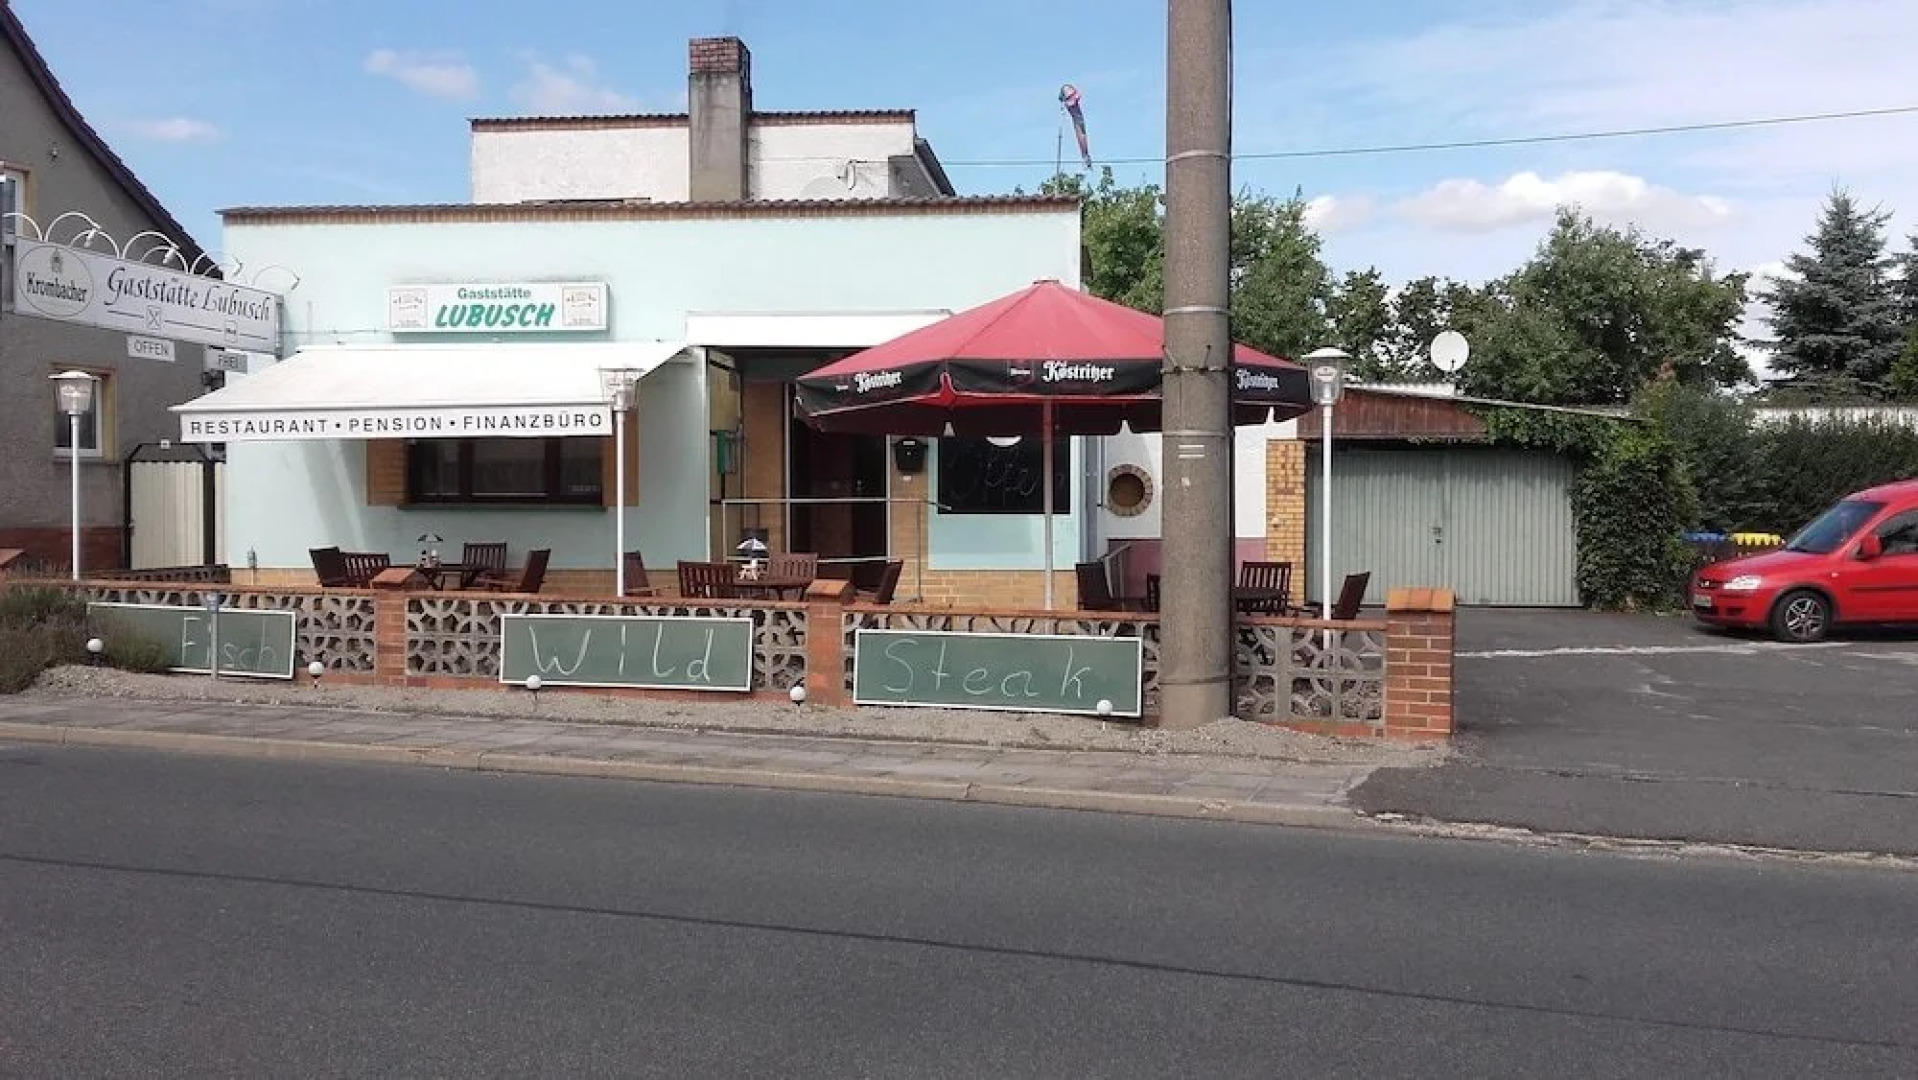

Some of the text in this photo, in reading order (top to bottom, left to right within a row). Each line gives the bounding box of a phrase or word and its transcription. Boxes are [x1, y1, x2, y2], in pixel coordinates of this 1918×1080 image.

[26, 272, 87, 303] Krombacher
[104, 266, 270, 321] Gaststätte Lubusch
[457, 287, 532, 300] Gaststätte
[435, 303, 556, 327] LUBUSCH
[134, 339, 169, 356] OFFEN
[190, 410, 602, 435] RESTAURANT PENSION FINANZBÜRO
[529, 622, 715, 683] Wild
[884, 639, 1091, 699] Steak
